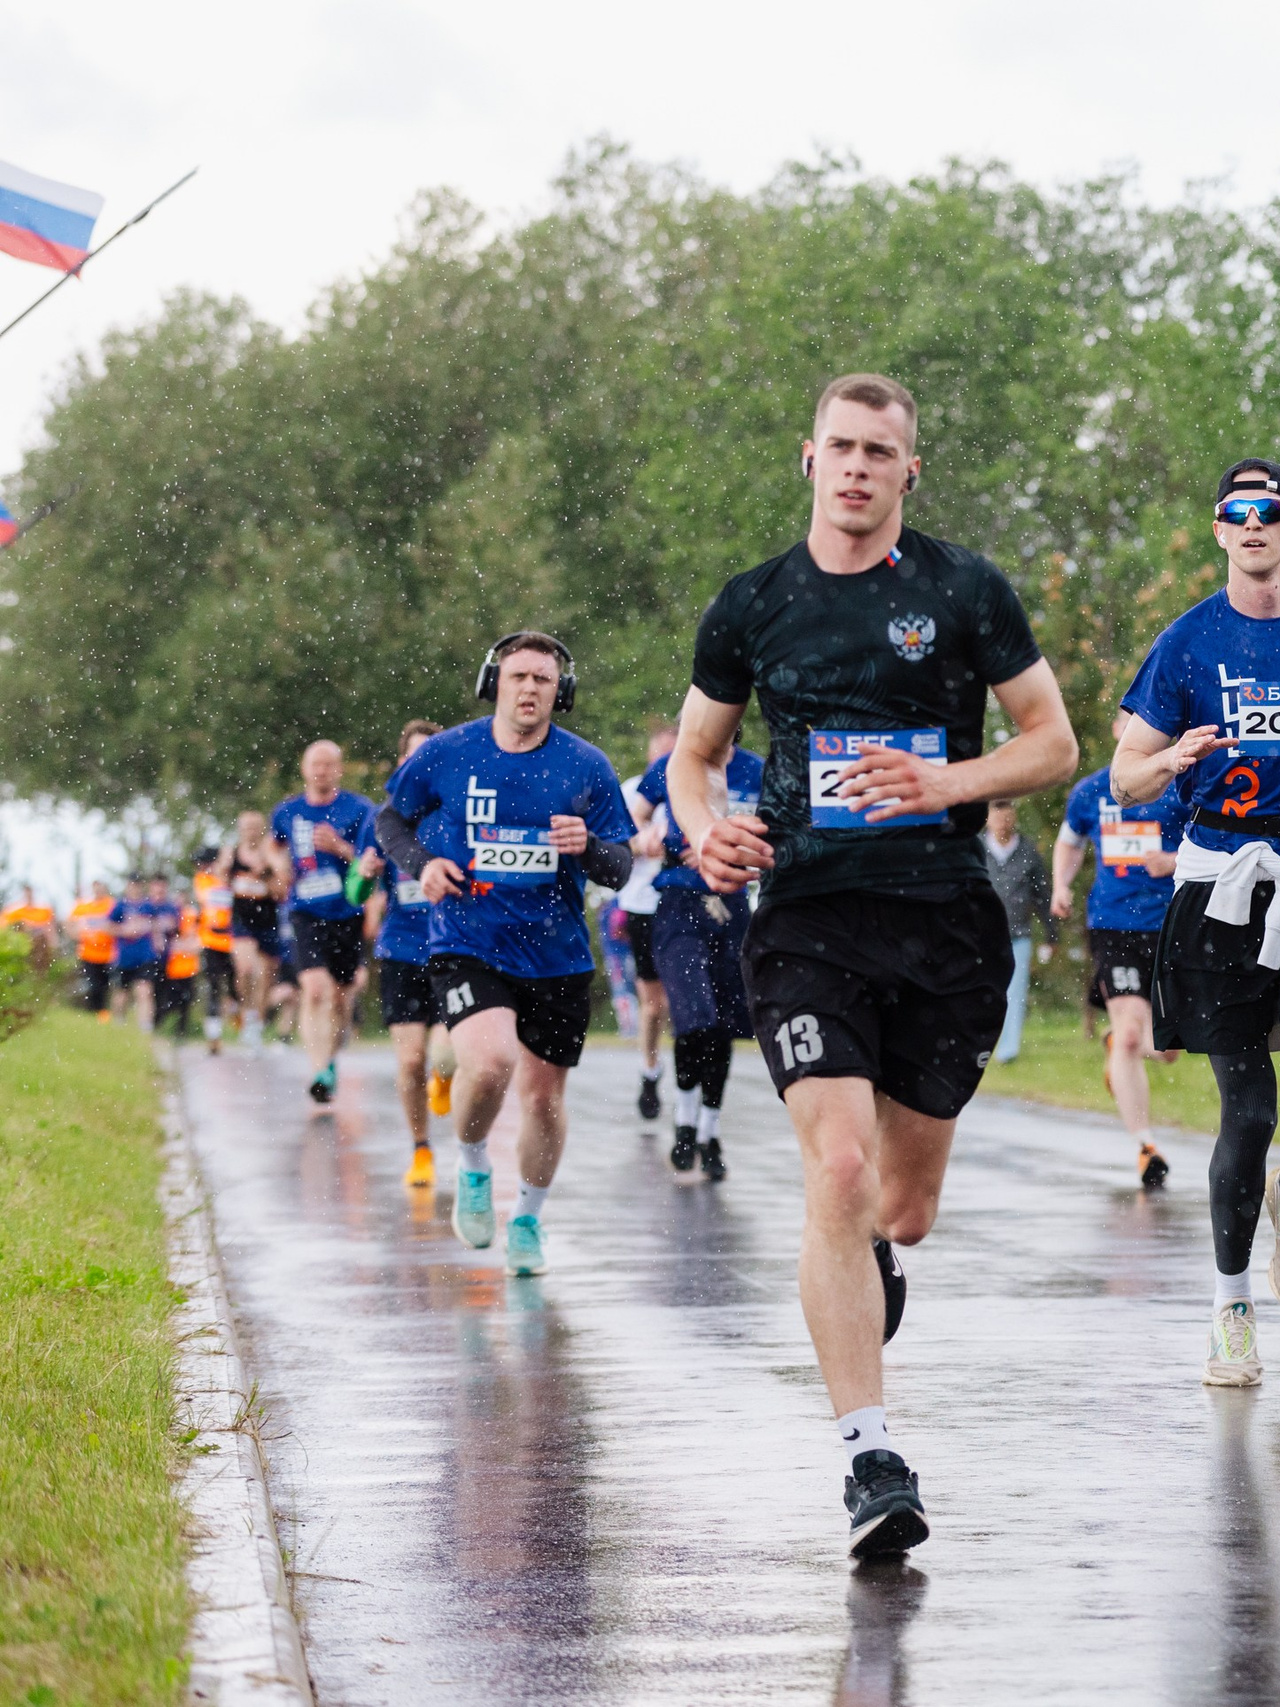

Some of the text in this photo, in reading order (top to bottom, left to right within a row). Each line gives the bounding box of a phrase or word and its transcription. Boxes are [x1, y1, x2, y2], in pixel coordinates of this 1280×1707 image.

[481, 848, 552, 867] 2074
[1123, 838, 1142, 852] 71
[446, 981, 476, 1015] 41
[774, 1014, 824, 1071] 13
